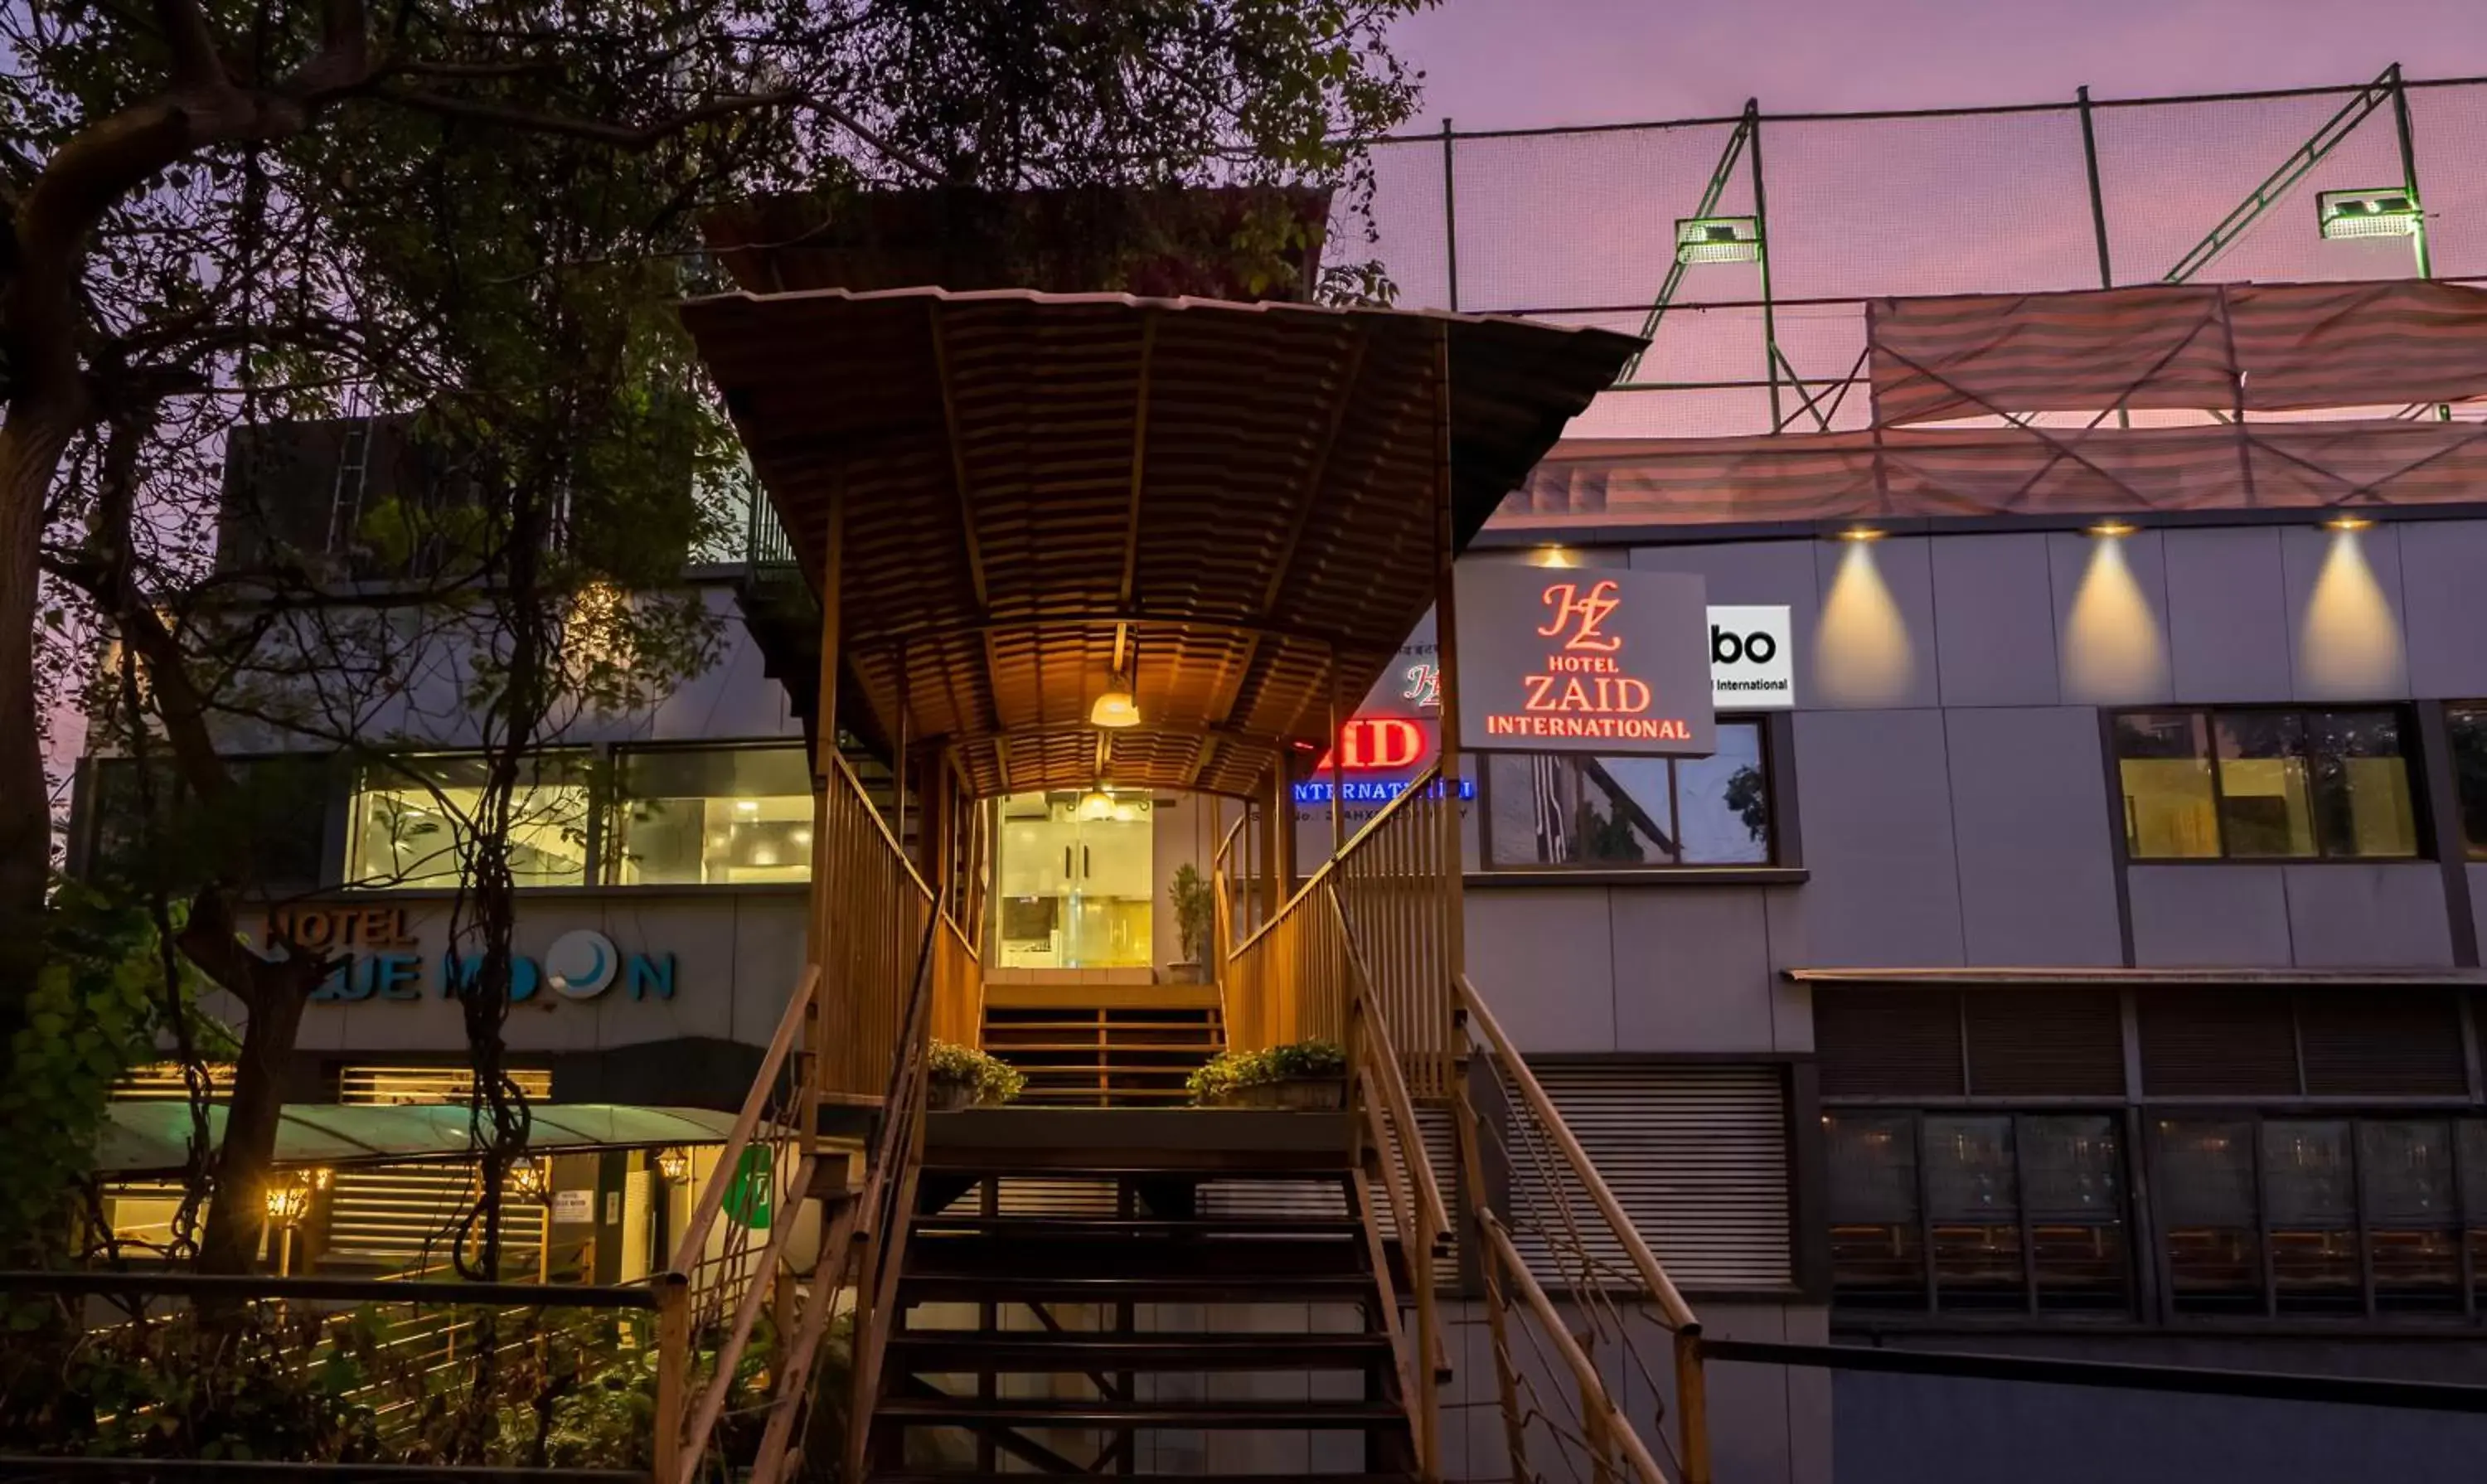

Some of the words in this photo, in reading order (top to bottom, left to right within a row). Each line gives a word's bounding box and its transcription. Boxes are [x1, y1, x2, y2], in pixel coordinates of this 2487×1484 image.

[1549, 656, 1620, 673] HOTEL
[1524, 676, 1651, 714] ZAID
[1717, 678, 1788, 691] International
[1487, 715, 1691, 740] INTERNATIONAL
